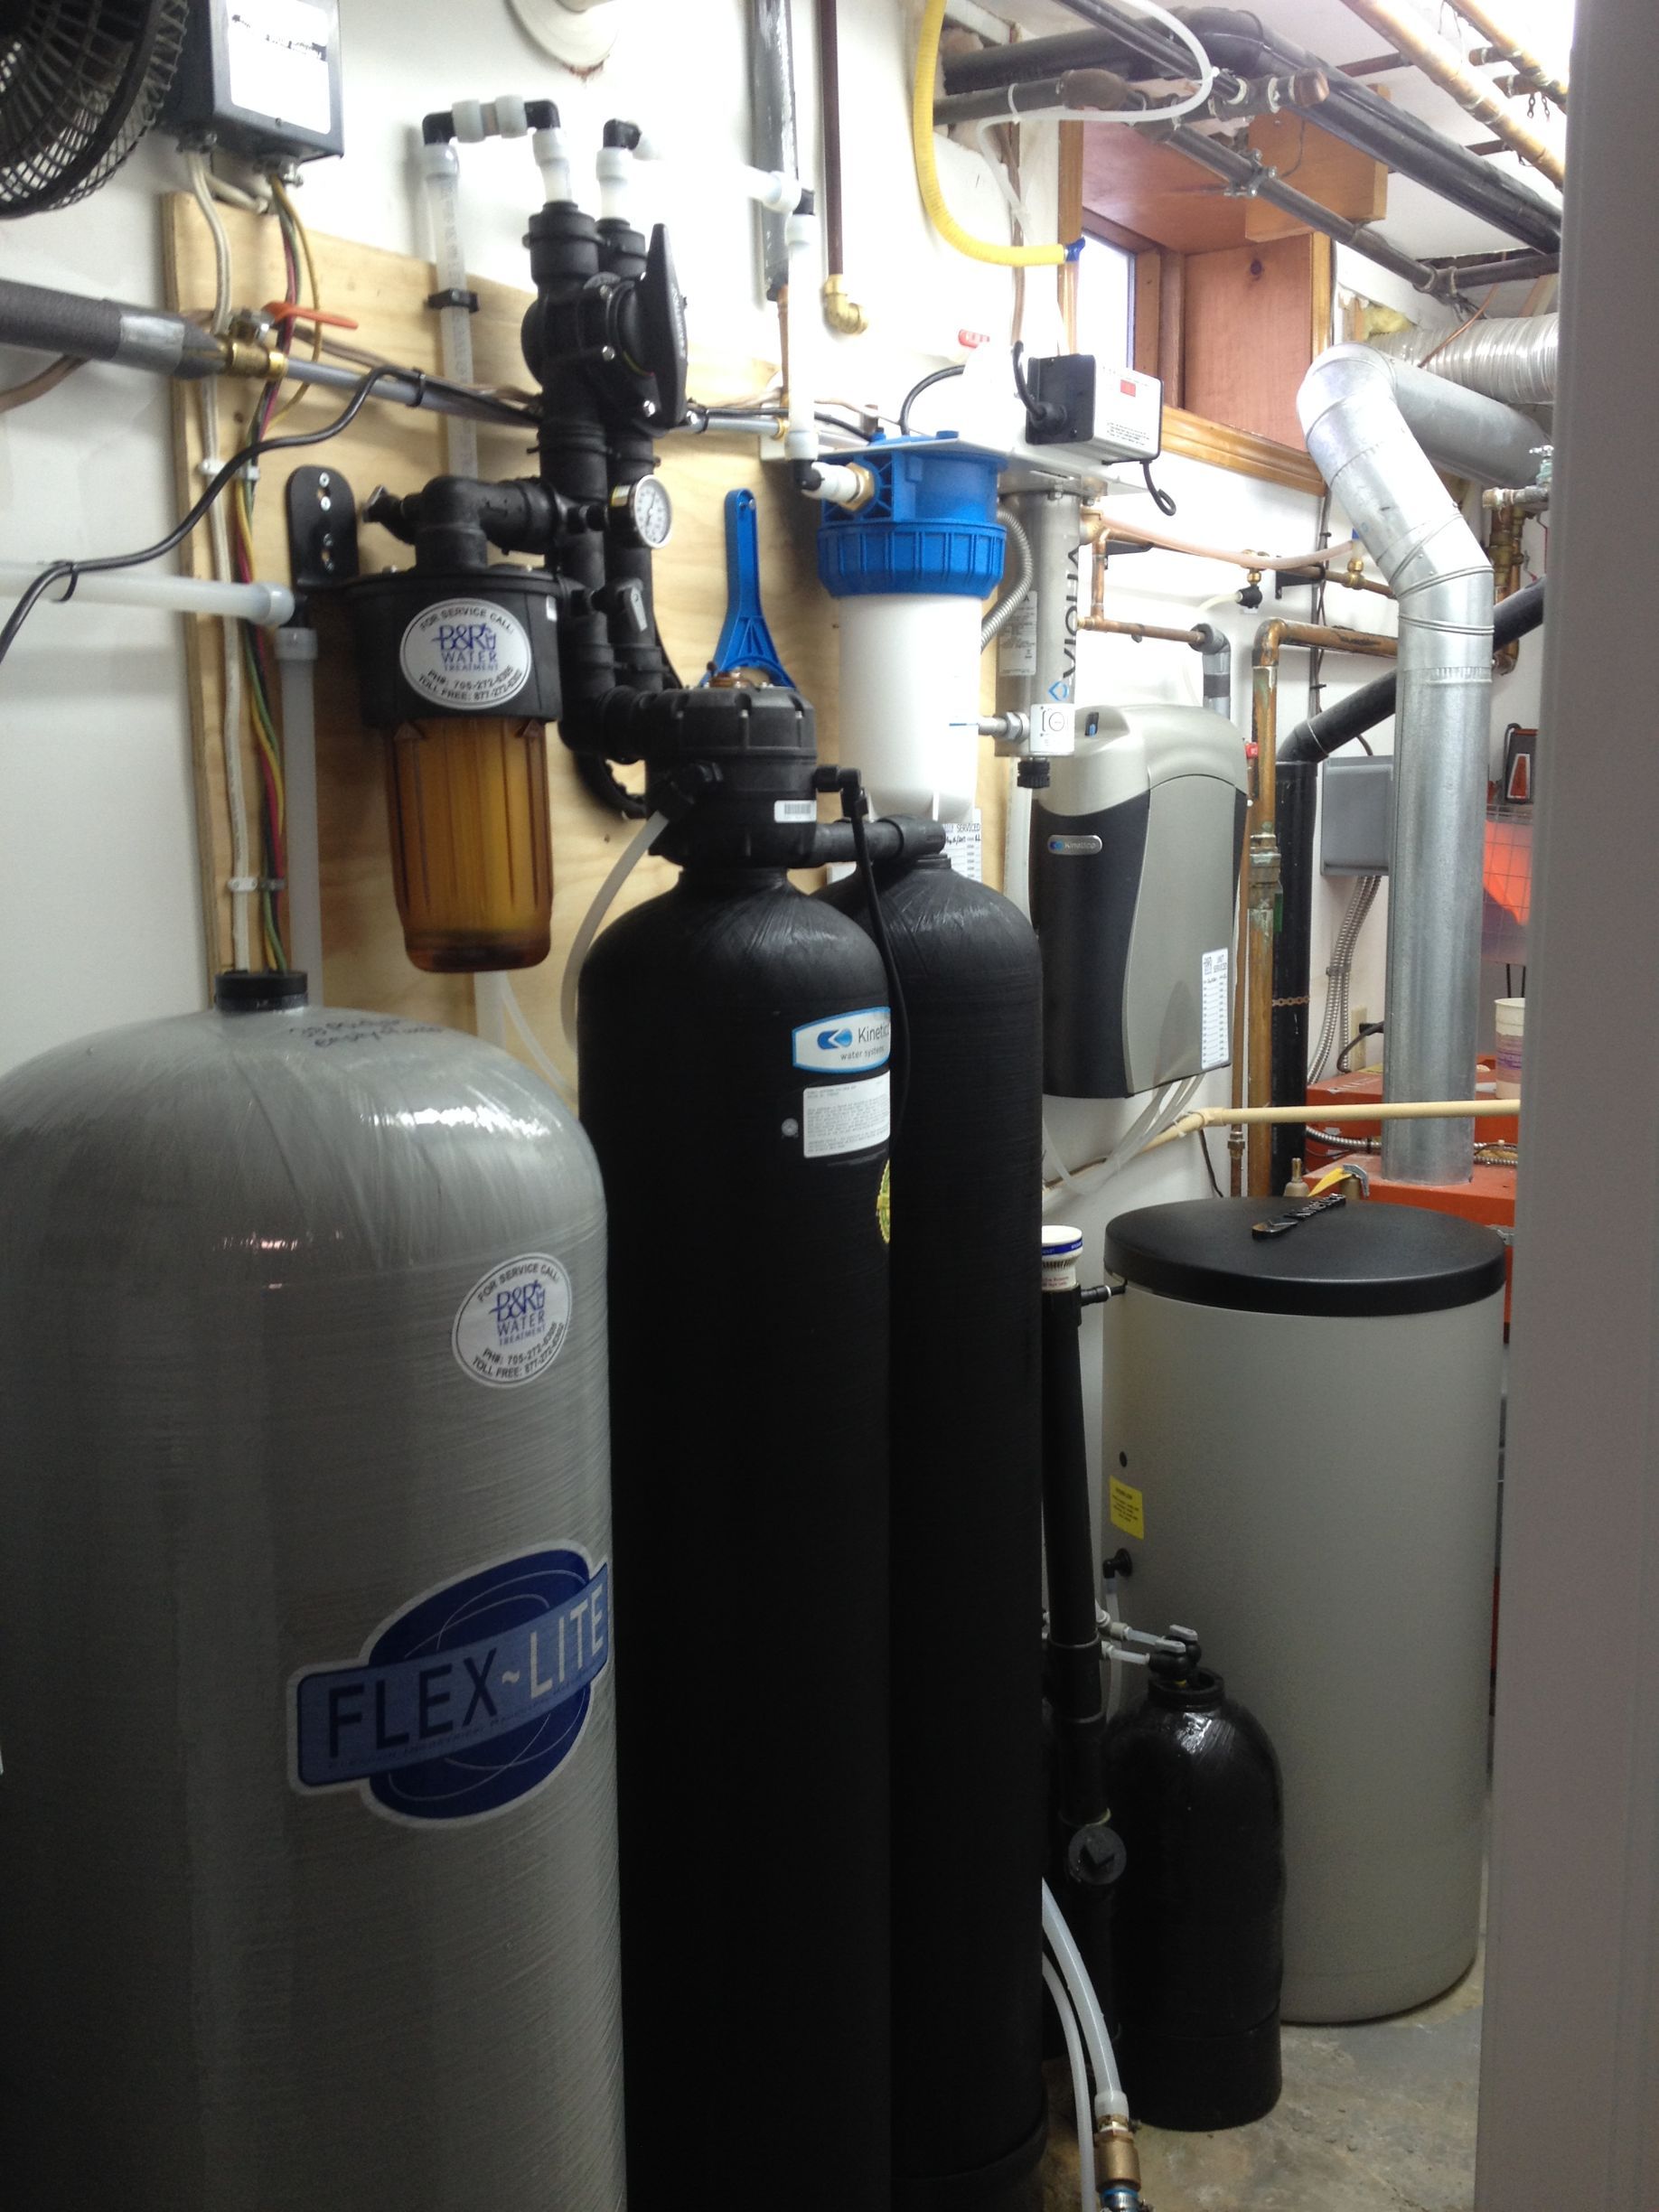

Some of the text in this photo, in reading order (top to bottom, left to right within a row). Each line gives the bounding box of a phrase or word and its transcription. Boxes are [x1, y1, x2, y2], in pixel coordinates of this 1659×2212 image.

[419, 614, 439, 632] FOR
[441, 607, 487, 619] SERVICE
[441, 650, 498, 664] WATER
[418, 673, 438, 693] TOLL
[441, 689, 472, 700] FREE:
[840, 1050, 863, 1061] water
[477, 1280, 498, 1303] FOR
[499, 1263, 539, 1284] SERVICE
[497, 1309, 546, 1336] WATER
[499, 1324, 547, 1345] TREATMENT
[473, 1356, 493, 1376] TOLL
[495, 1366, 522, 1378] FREE:
